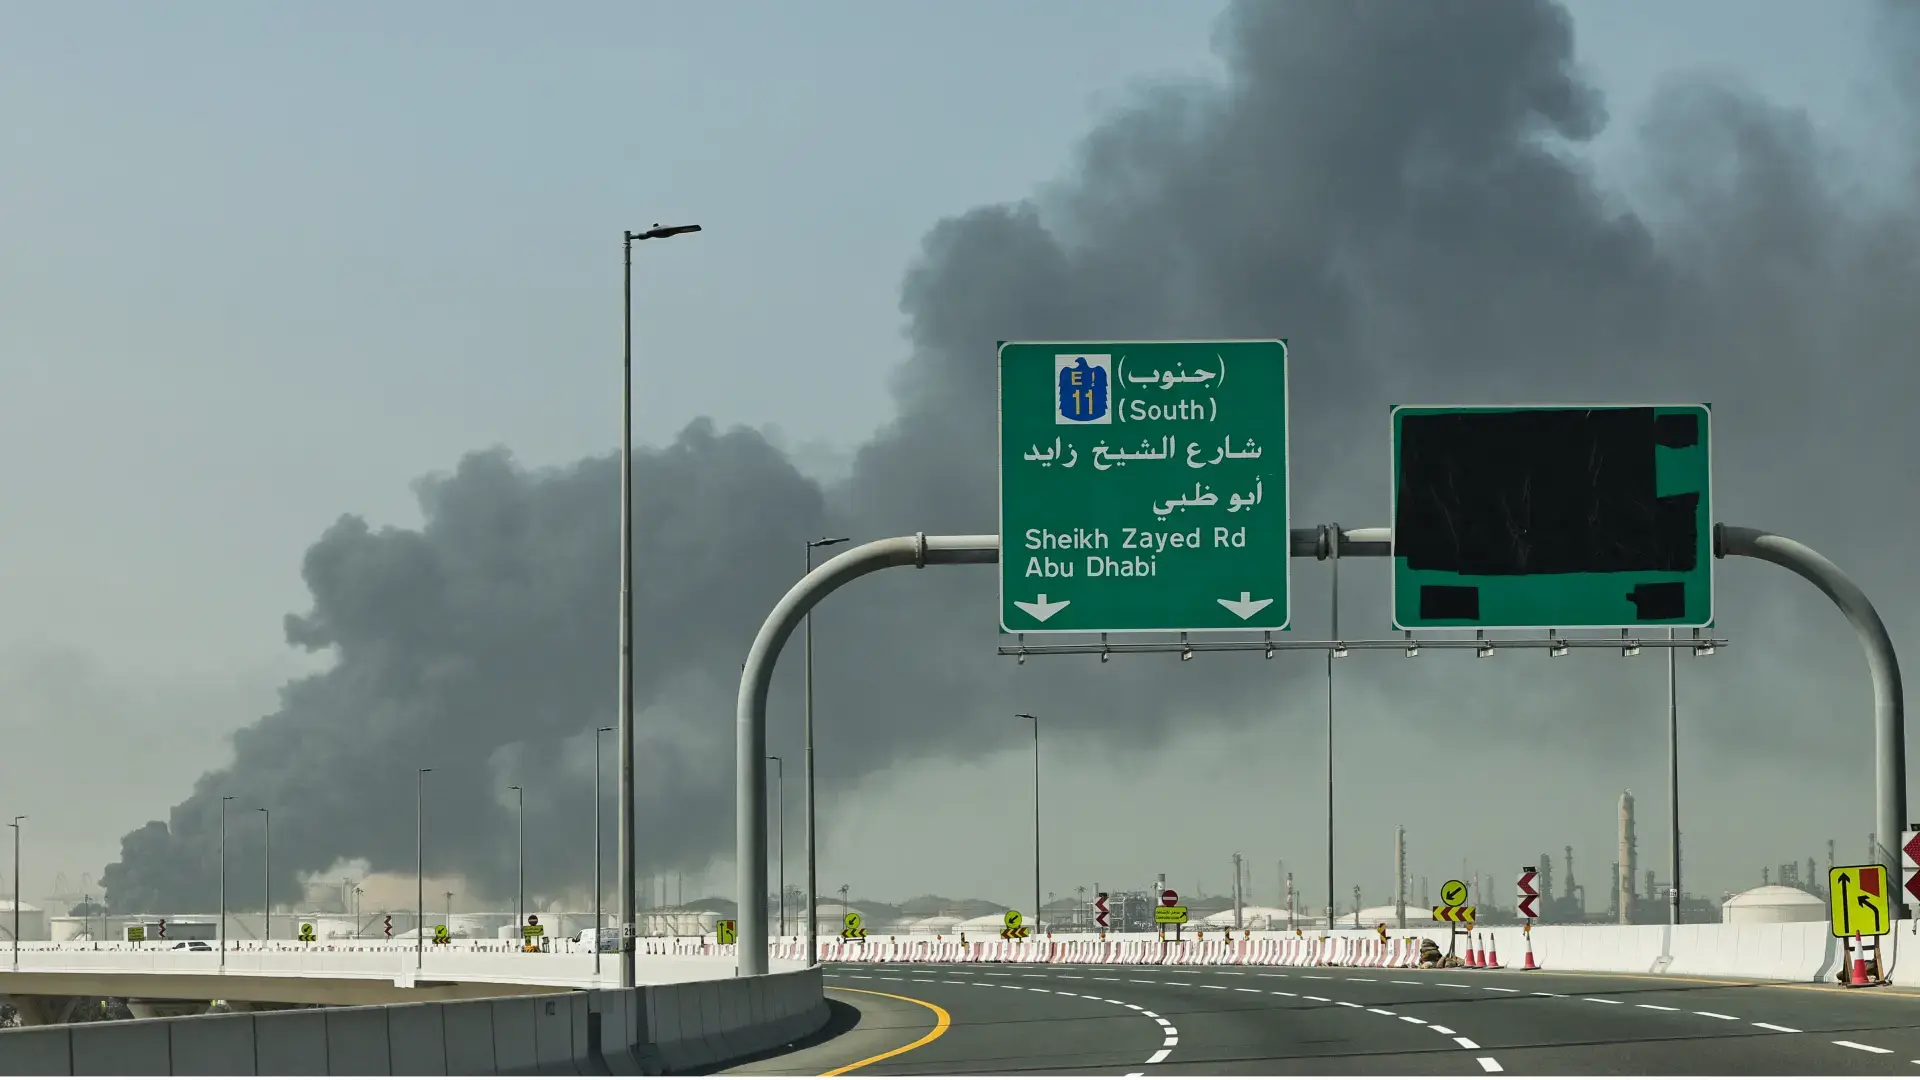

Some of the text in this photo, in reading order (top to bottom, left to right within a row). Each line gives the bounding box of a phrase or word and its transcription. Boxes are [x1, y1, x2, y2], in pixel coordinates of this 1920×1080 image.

[1071, 371, 1083, 386] E
[1117, 353, 1226, 390] (جنوب)
[1072, 389, 1094, 415] 11
[1118, 397, 1217, 423] (South)
[1023, 434, 1262, 471] شارع الشيخ زايد
[1152, 475, 1263, 522] أبو ظبي
[1024, 526, 1246, 552] Sheikh Zayed Rd
[1025, 554, 1156, 578] Abu Dhabi
